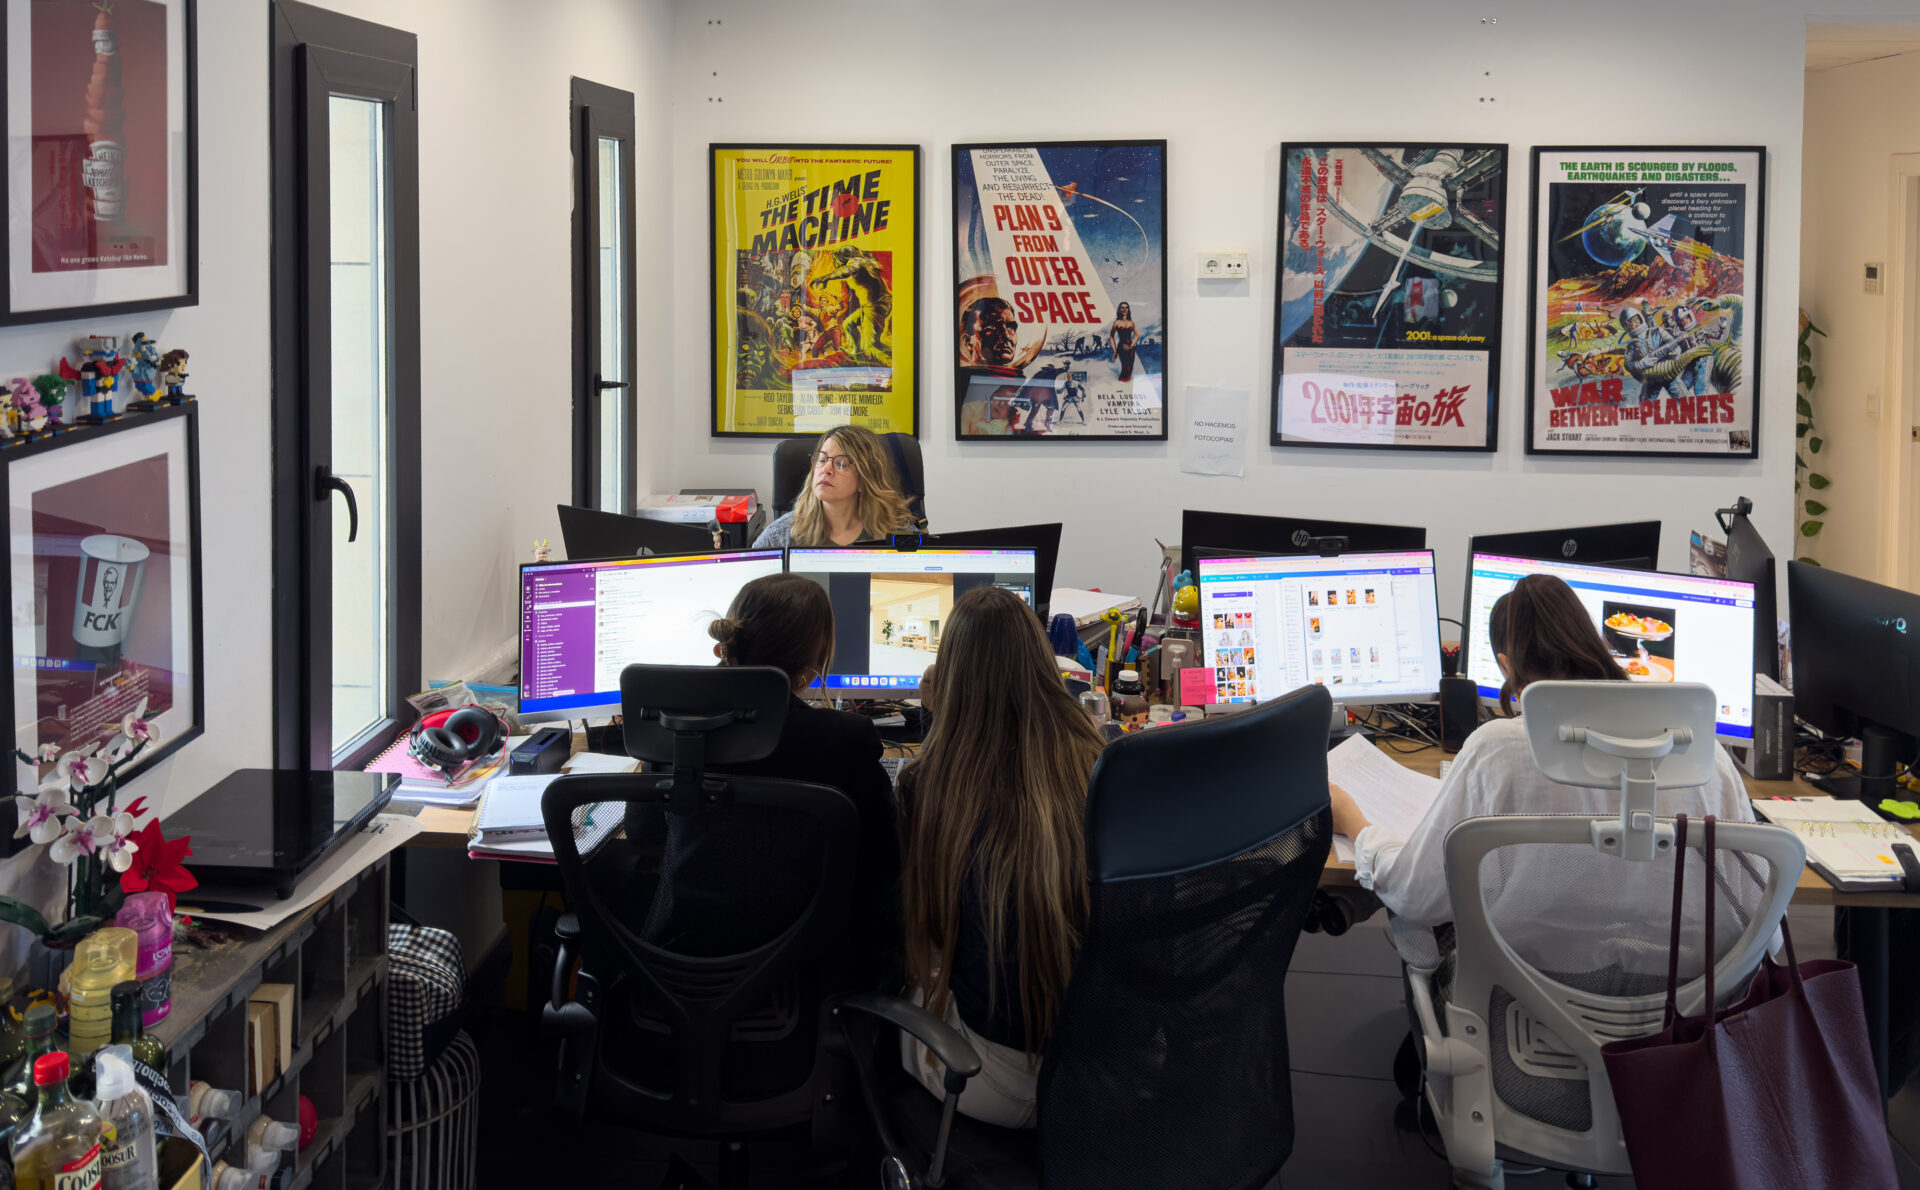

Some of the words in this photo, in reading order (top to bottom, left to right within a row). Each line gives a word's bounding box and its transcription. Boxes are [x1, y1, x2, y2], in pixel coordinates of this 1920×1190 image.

[1560, 162, 1578, 171] THE
[1580, 162, 1612, 171] EARTH
[1614, 162, 1625, 172] IS
[1628, 162, 1678, 172] SCOURGED
[1682, 162, 1695, 172] BY
[1567, 172, 1638, 182] EARTHQUAKES
[1641, 172, 1662, 182] AND
[992, 174, 1010, 182] THE
[1011, 174, 1037, 182] LIVING
[760, 199, 799, 230] THE
[803, 170, 882, 217] TIME
[998, 192, 1018, 201] THE
[1019, 192, 1045, 201] DEAD!
[993, 204, 1045, 231] PLAN
[1042, 204, 1063, 231] 9
[750, 200, 891, 260] MACHINE
[1012, 234, 1060, 252] FROM
[1005, 256, 1086, 286] OUTER
[1013, 292, 1102, 324] SPACE
[1550, 378, 1624, 408] WAR
[1302, 380, 1472, 428] 2001年宇宙の旅
[1549, 403, 1619, 428] BETWEEN
[1620, 406, 1640, 420] THE
[1640, 392, 1735, 426] PLANETS
[1205, 422, 1236, 430] HACEMOS
[1194, 434, 1234, 443] FOTOCOPIAS
[1546, 433, 1560, 441] JACK
[1562, 433, 1582, 441] STUART
[1294, 530, 1308, 546] hp
[83, 611, 122, 631] FCK
[101, 1146, 136, 1167] OOSUR
